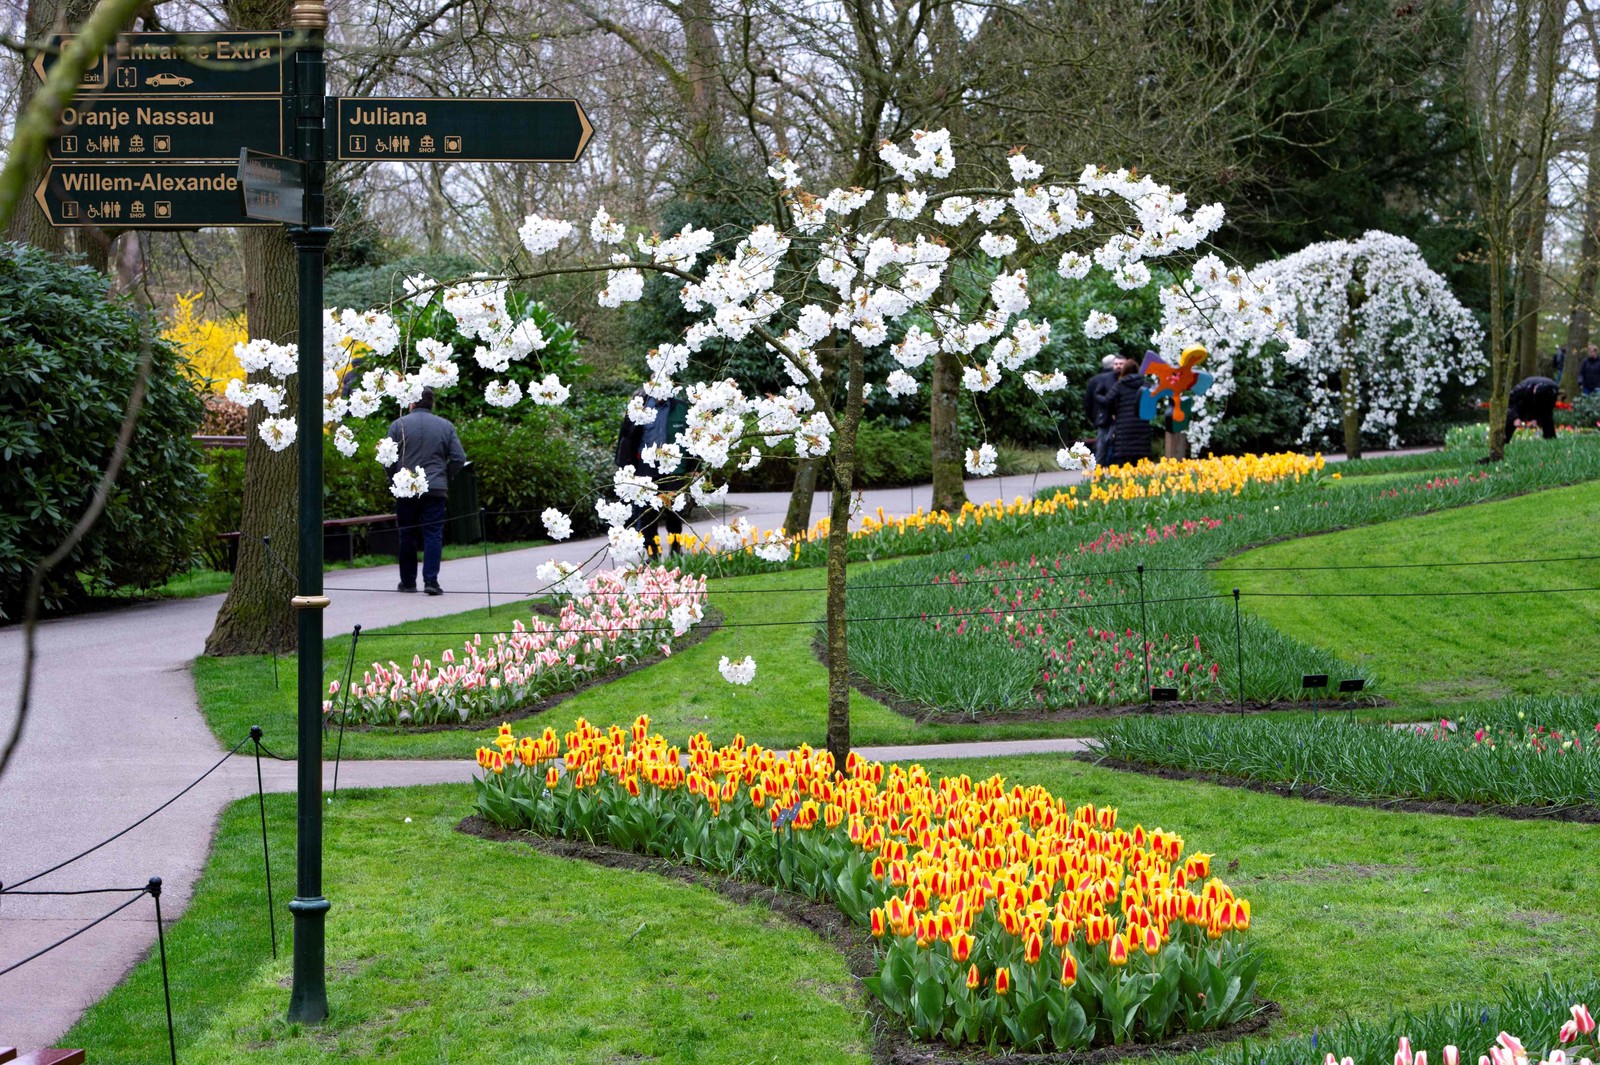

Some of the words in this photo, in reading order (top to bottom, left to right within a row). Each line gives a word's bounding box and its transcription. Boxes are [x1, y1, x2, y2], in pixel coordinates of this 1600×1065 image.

[116, 41, 210, 60] Entrance
[216, 41, 271, 60] Extra
[84, 74, 100, 82] Exit
[60, 107, 130, 130] Oranje
[136, 107, 214, 126] Nassau
[349, 106, 427, 125] Juliana
[61, 173, 238, 192] Willem-Alexande
